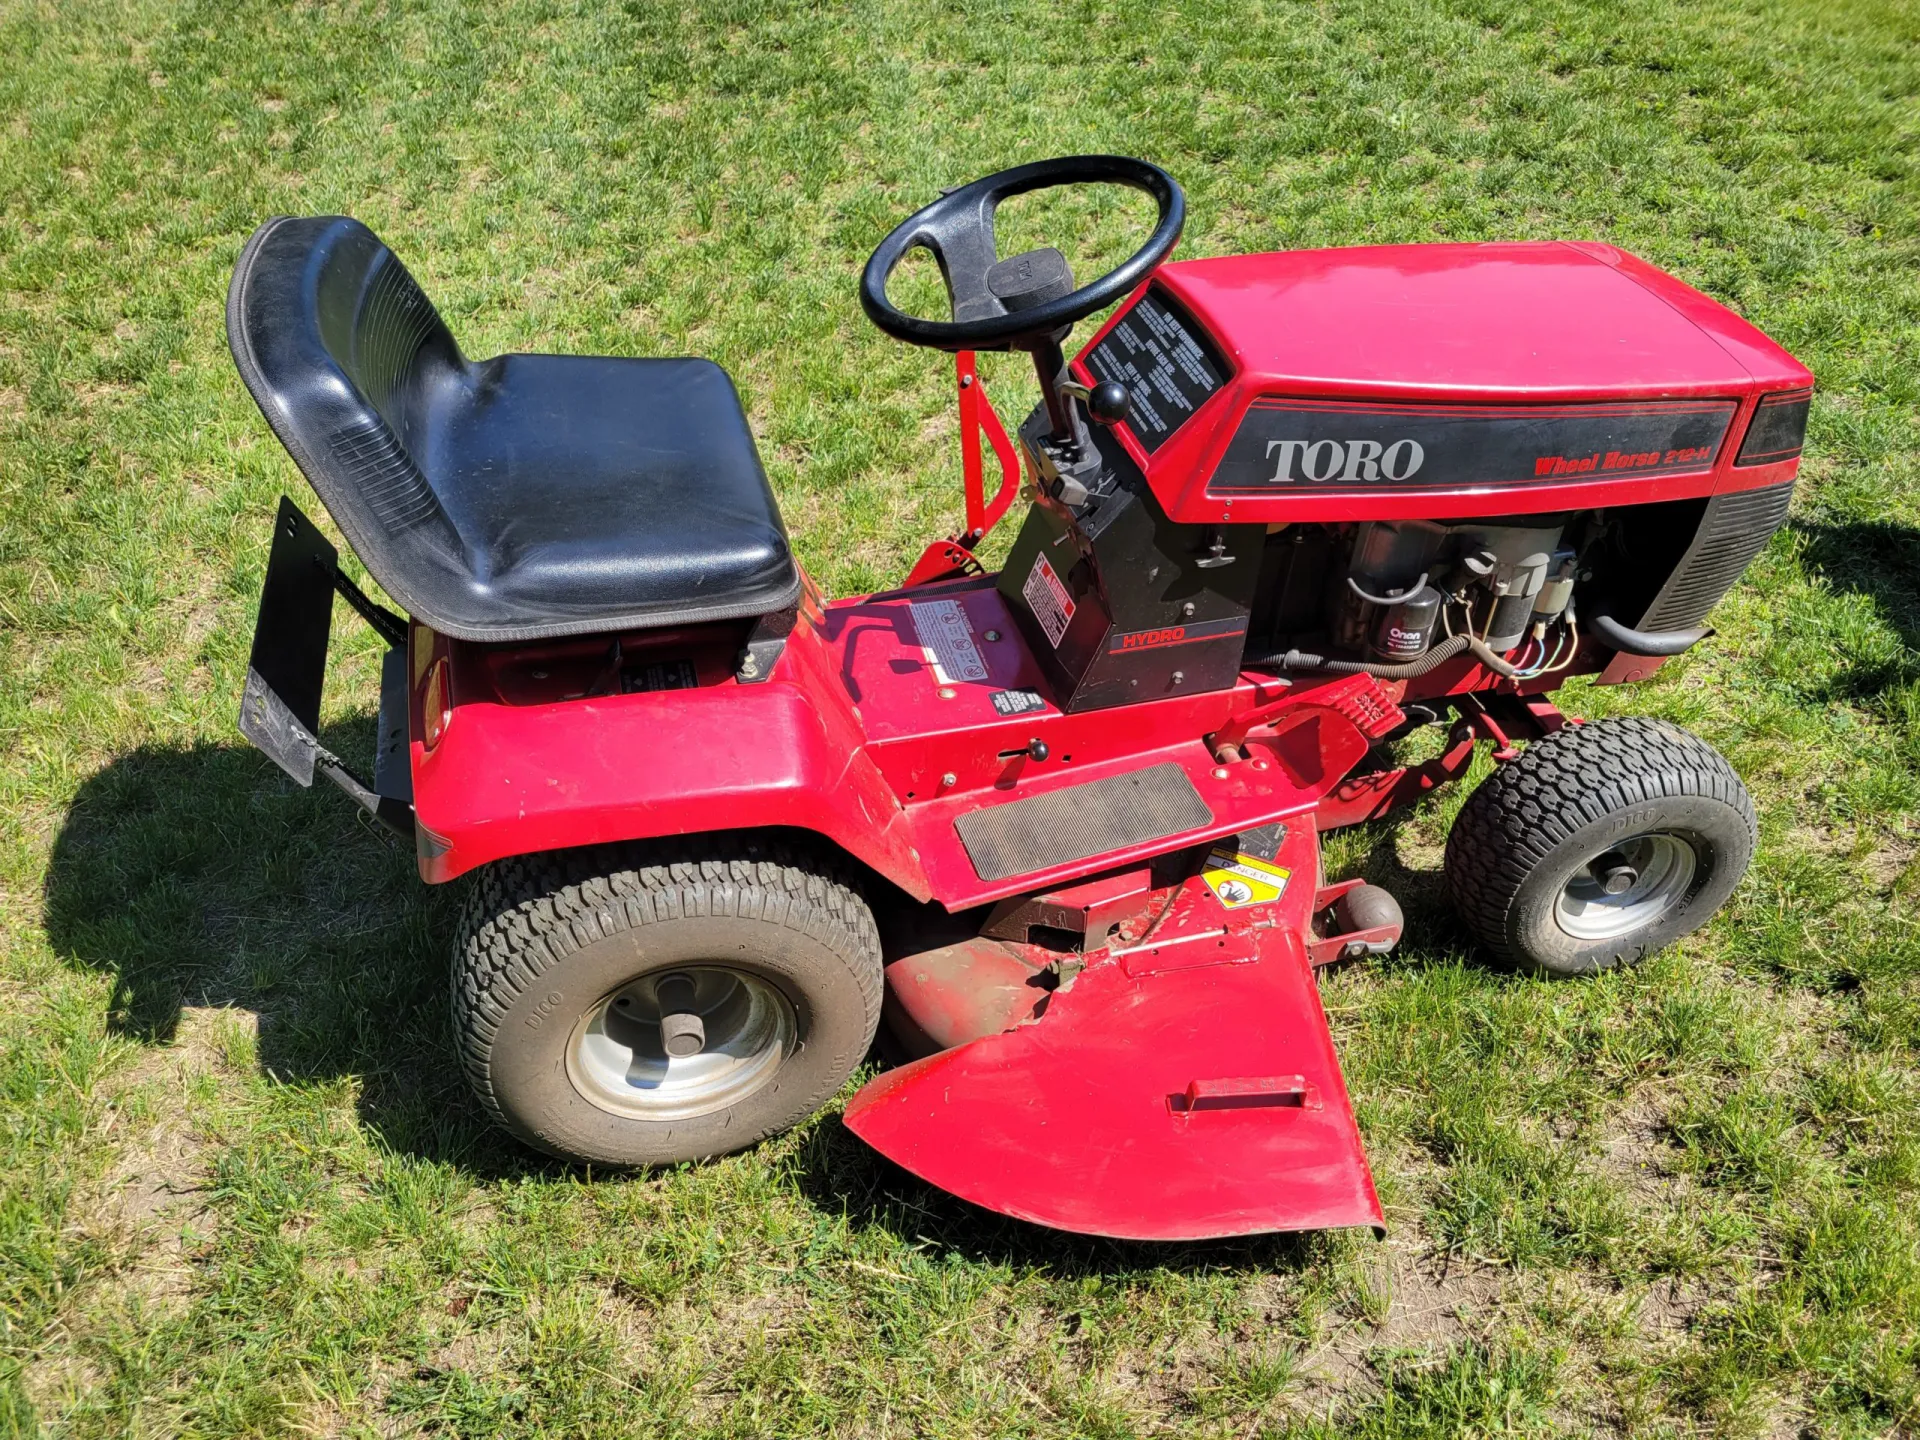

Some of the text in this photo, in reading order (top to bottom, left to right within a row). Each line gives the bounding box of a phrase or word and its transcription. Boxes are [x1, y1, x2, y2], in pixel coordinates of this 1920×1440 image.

[1265, 439, 1424, 482] TORO
[1534, 446, 1712, 475] Wheel Horse 212-H
[957, 606, 975, 634] DANGER
[1390, 628, 1420, 640] Onan
[1123, 627, 1185, 648] HYDRO
[523, 991, 563, 1031] DICO
